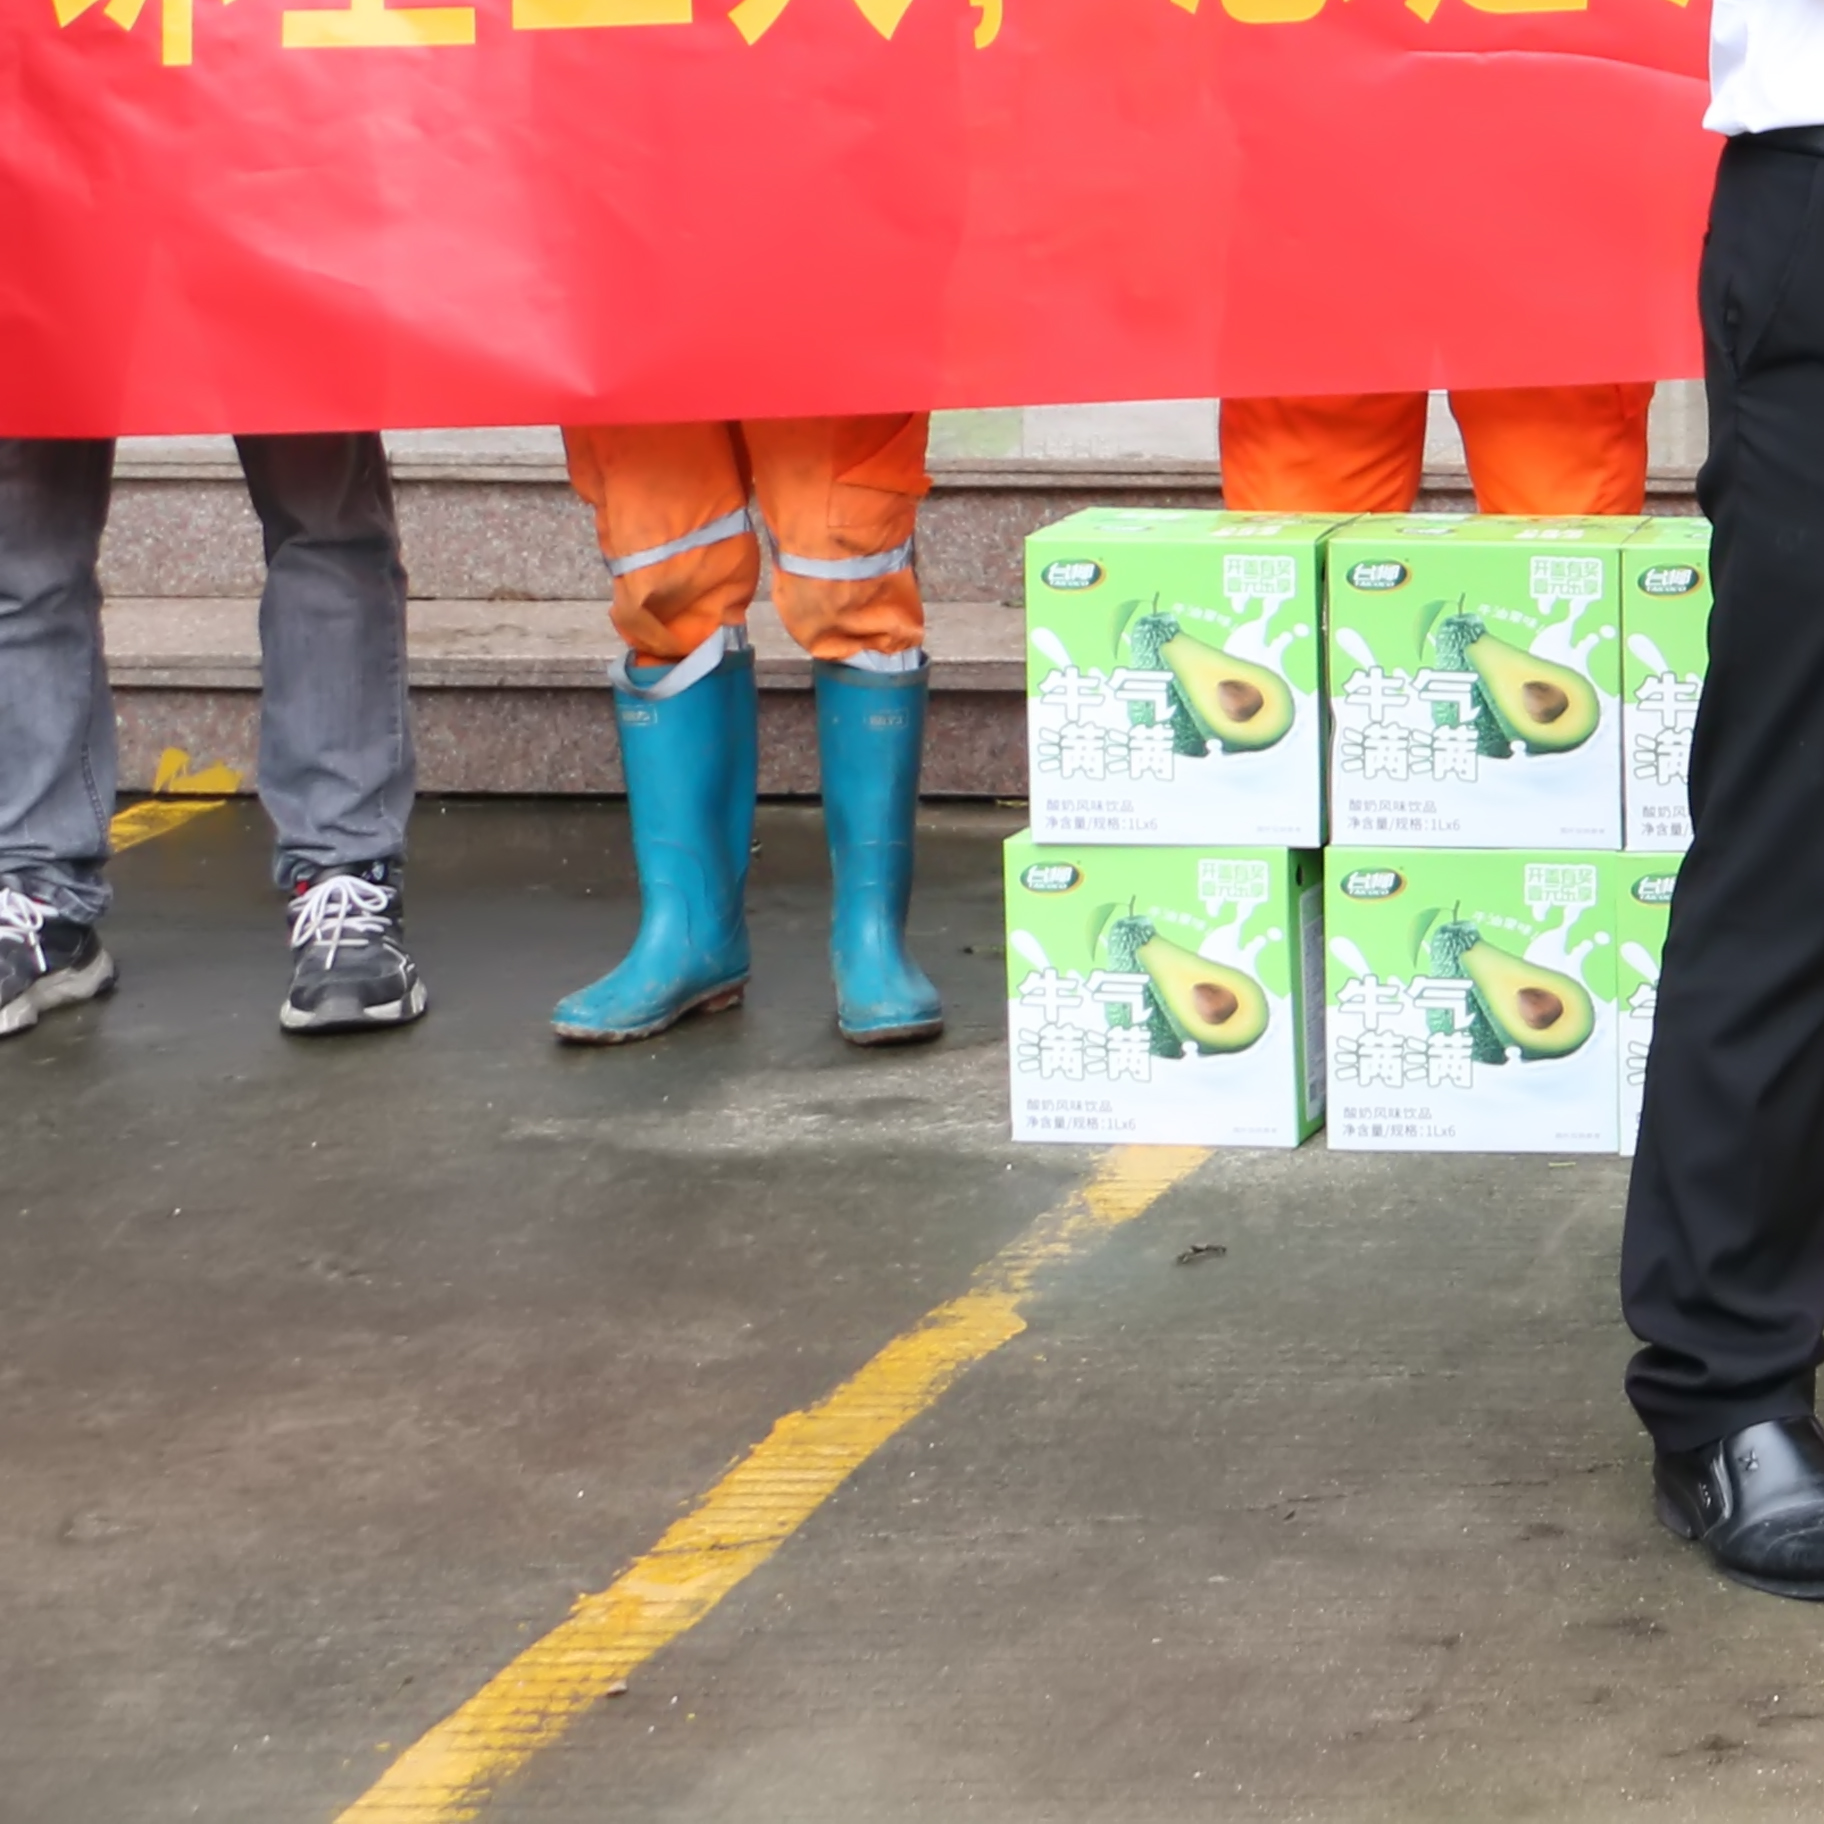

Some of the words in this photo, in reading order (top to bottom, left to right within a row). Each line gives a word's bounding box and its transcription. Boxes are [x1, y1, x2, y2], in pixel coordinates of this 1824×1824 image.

[1039, 665, 1176, 723] 牛气
[1342, 666, 1480, 723] 牛气
[1038, 722, 1175, 782] 满满
[1341, 722, 1480, 783] 满满
[1348, 799, 1437, 814] 酸奶风味饮品
[1641, 822, 1692, 837] 净含量/
[1018, 966, 1153, 1024] 牛气
[1335, 973, 1476, 1031] 牛气
[1017, 1022, 1152, 1083] 满满
[1334, 1030, 1474, 1089] 满满
[1343, 1106, 1433, 1121] 酸奶风味饮品
